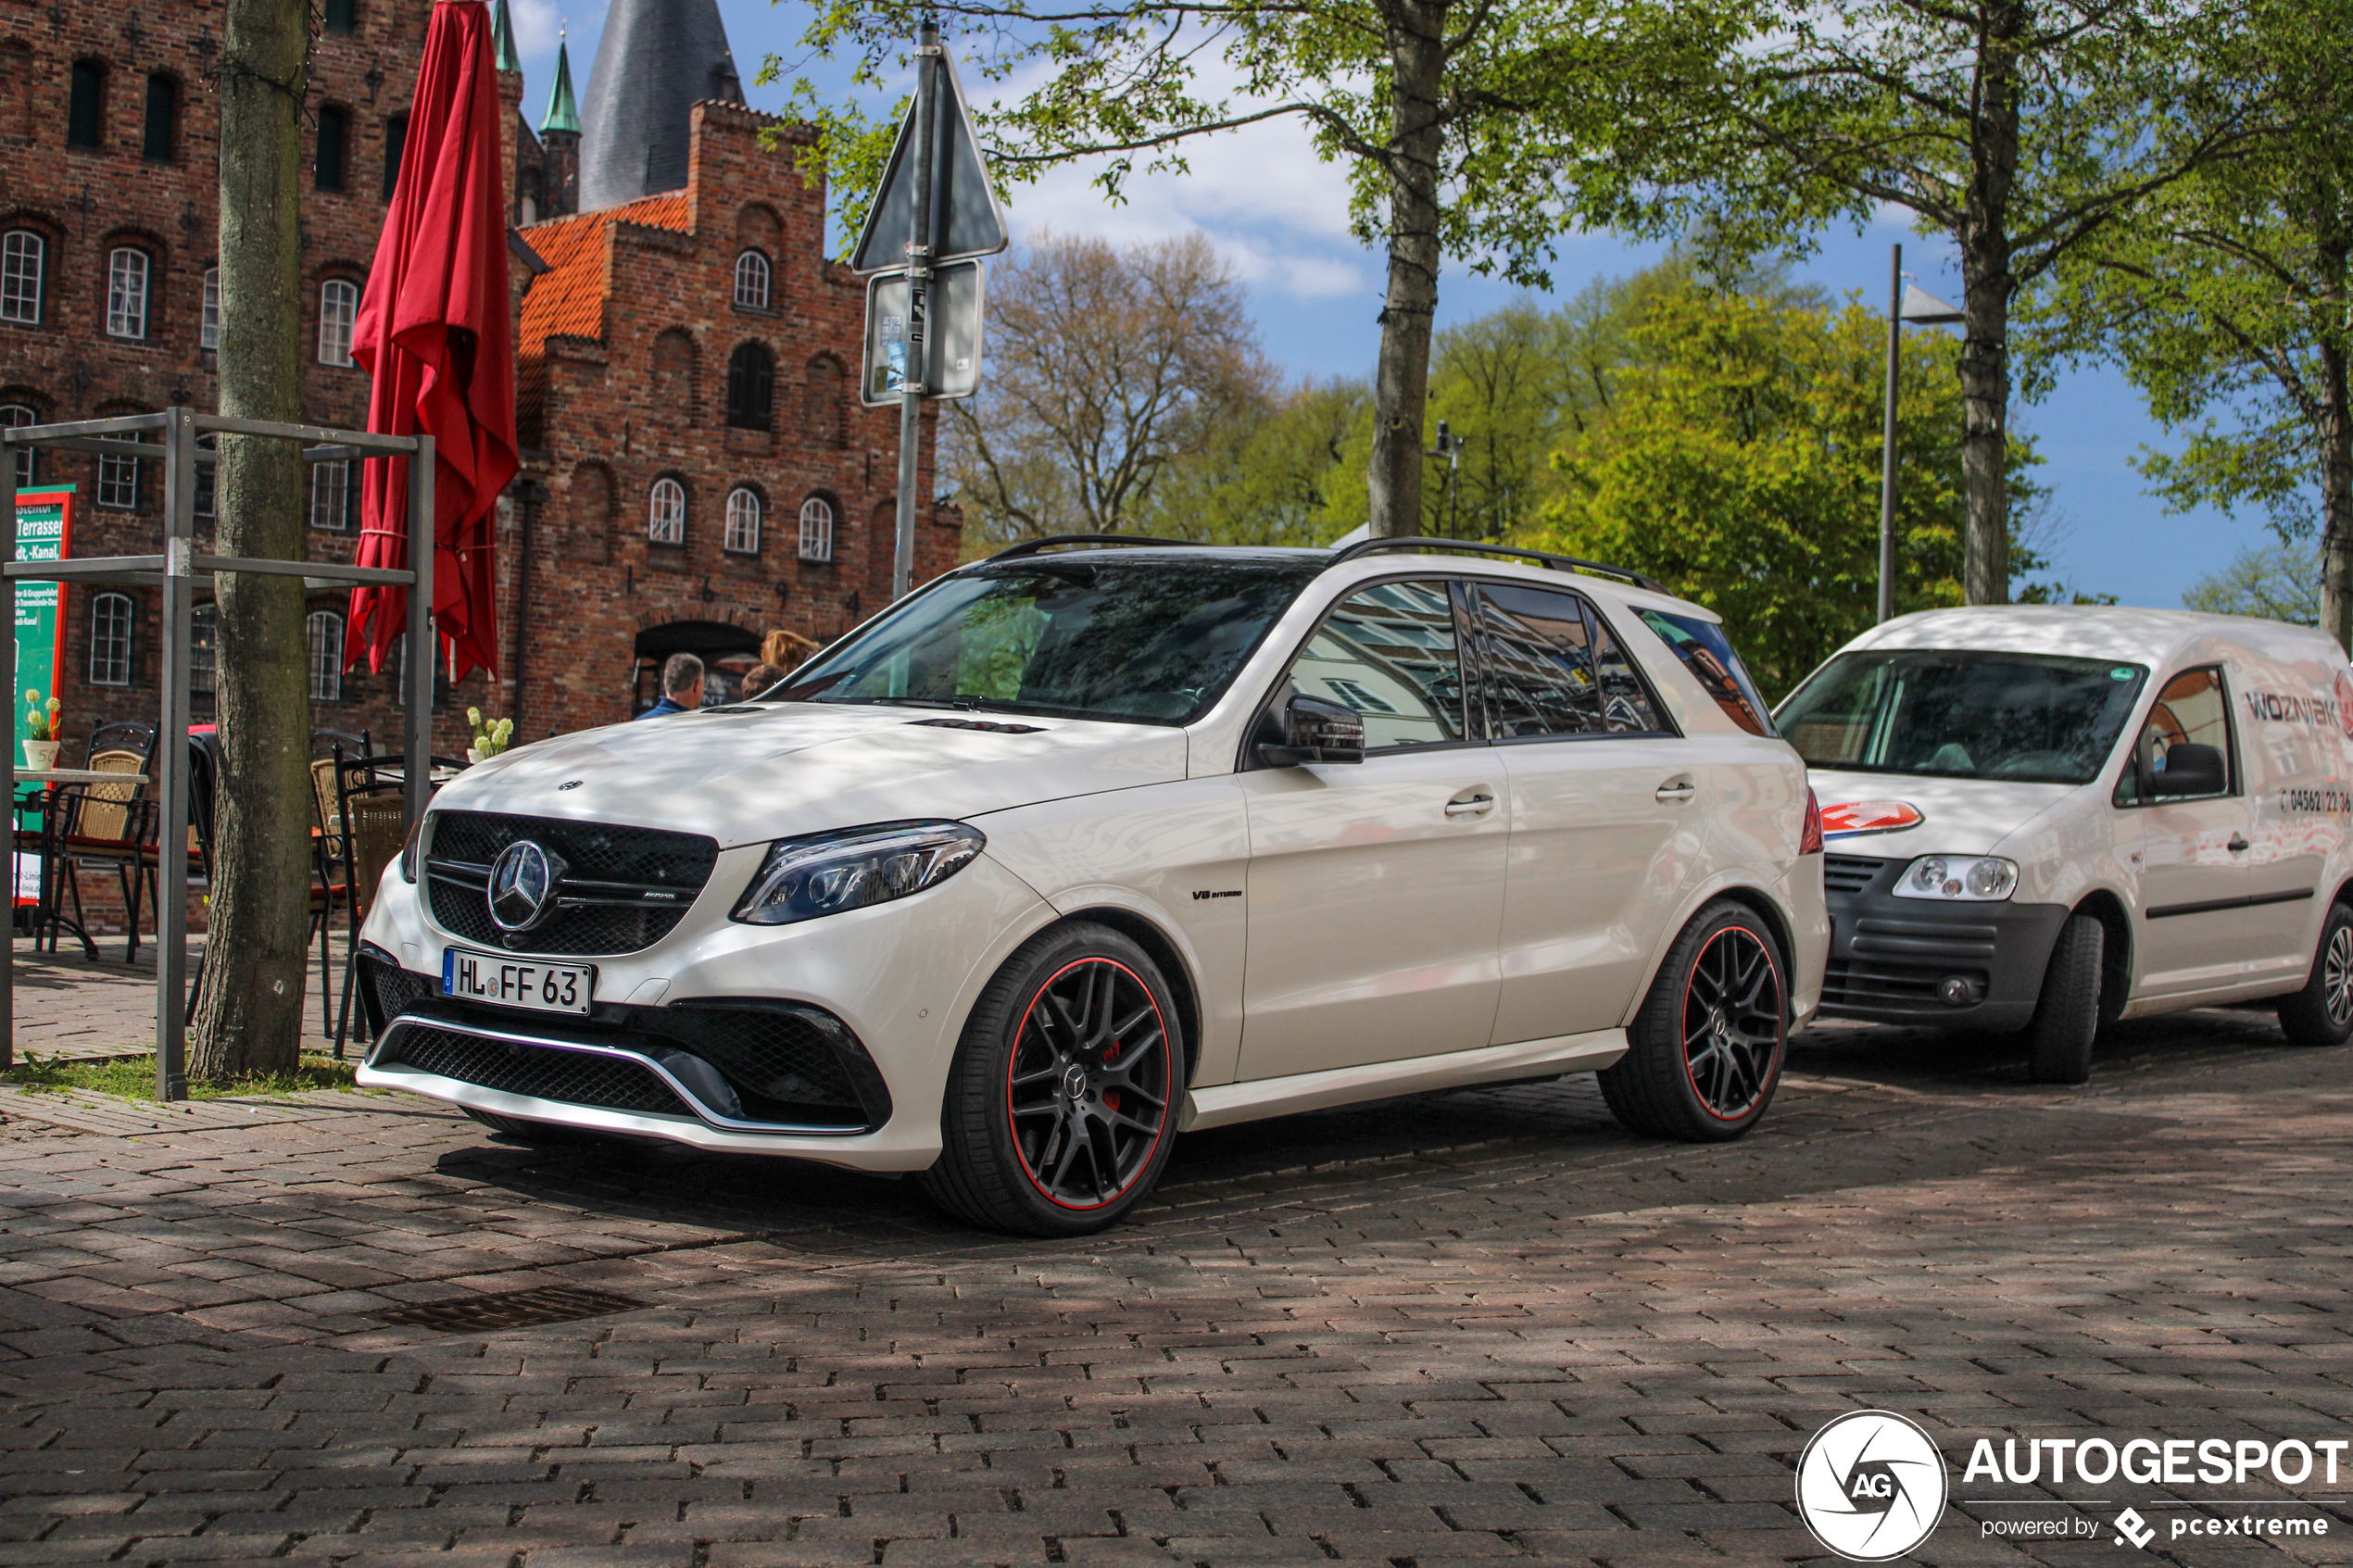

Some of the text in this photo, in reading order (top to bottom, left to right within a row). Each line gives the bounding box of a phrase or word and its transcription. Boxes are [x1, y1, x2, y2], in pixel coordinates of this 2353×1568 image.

[1192, 890, 1242, 900] V8 BITURBO
[459, 958, 577, 1006] HL FF 63
